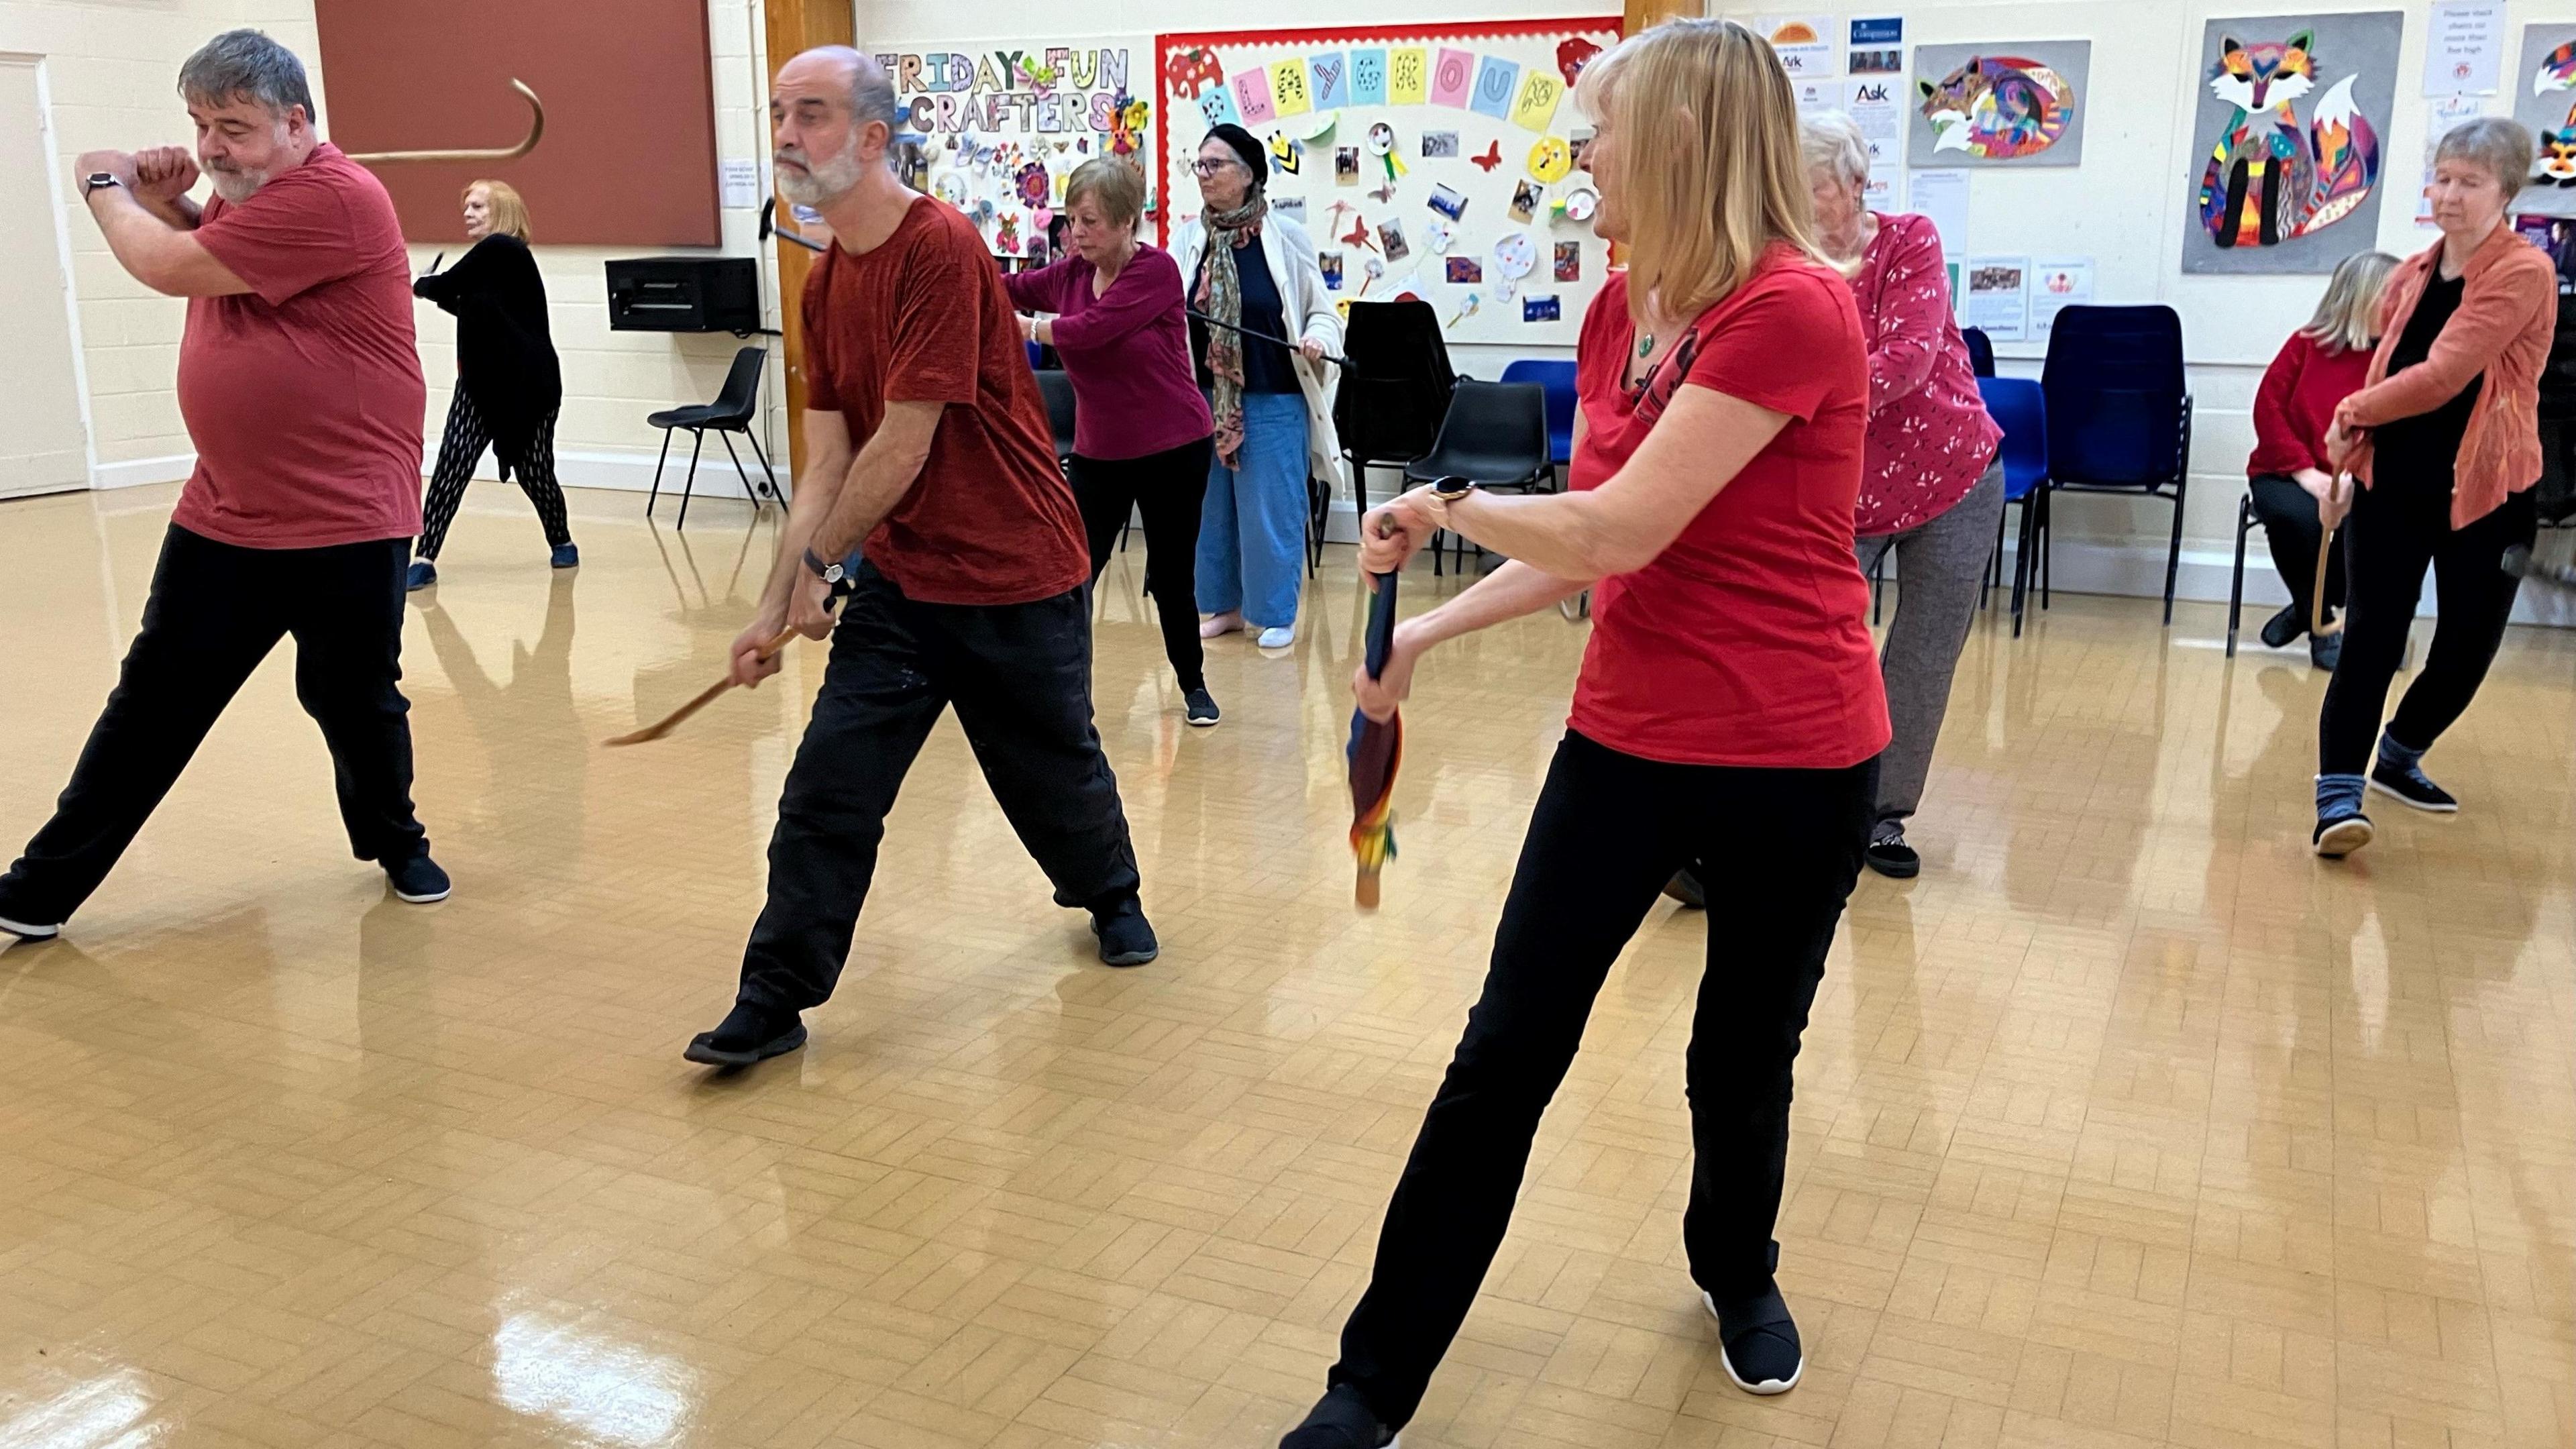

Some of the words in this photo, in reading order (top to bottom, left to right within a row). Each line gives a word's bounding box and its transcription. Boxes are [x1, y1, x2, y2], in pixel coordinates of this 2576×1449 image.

[875, 50, 1024, 97] FRIDAY
[1045, 47, 1130, 90] FUN
[1854, 84, 1889, 103] Ask
[908, 92, 1116, 133] CRAFTERS
[1869, 143, 1880, 156] rk
